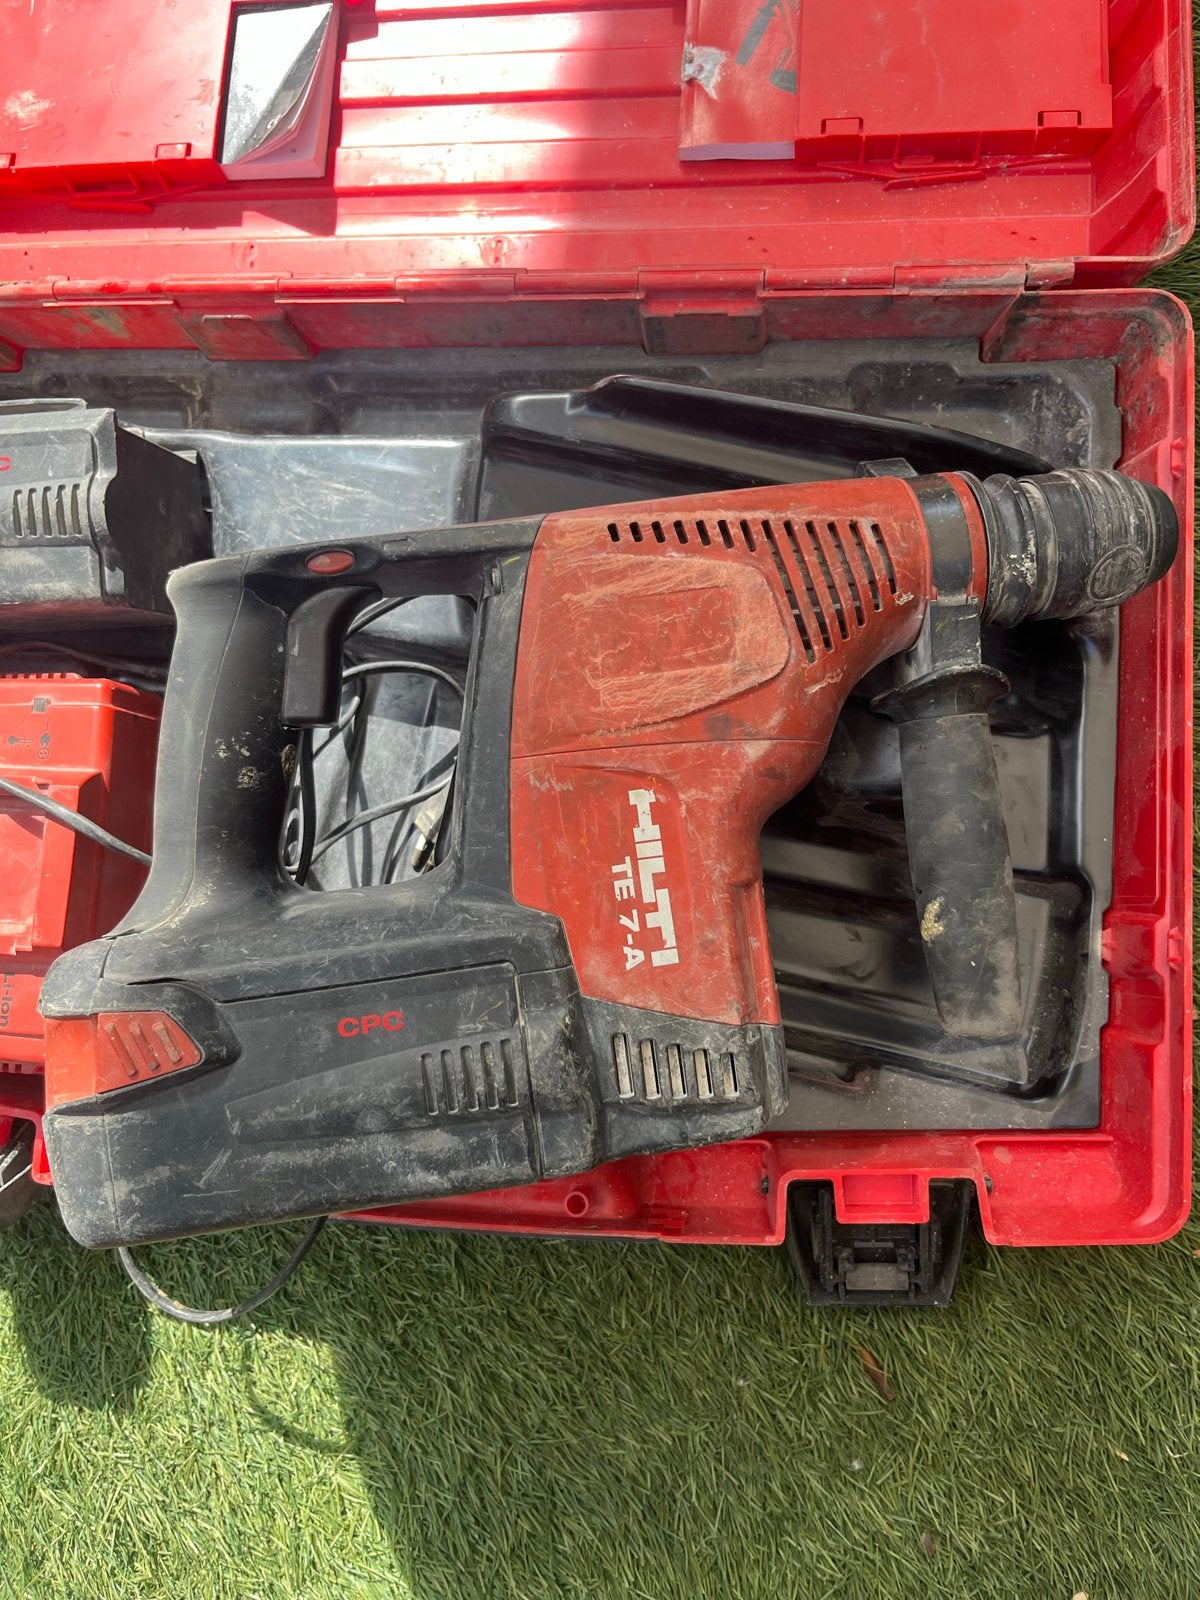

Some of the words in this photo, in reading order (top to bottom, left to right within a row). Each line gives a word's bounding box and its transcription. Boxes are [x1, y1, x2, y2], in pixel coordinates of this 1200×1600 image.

[611, 855, 636, 901] TE
[628, 788, 680, 967] HILTI
[619, 908, 645, 971] 7-A
[337, 1010, 404, 1038] CPC
